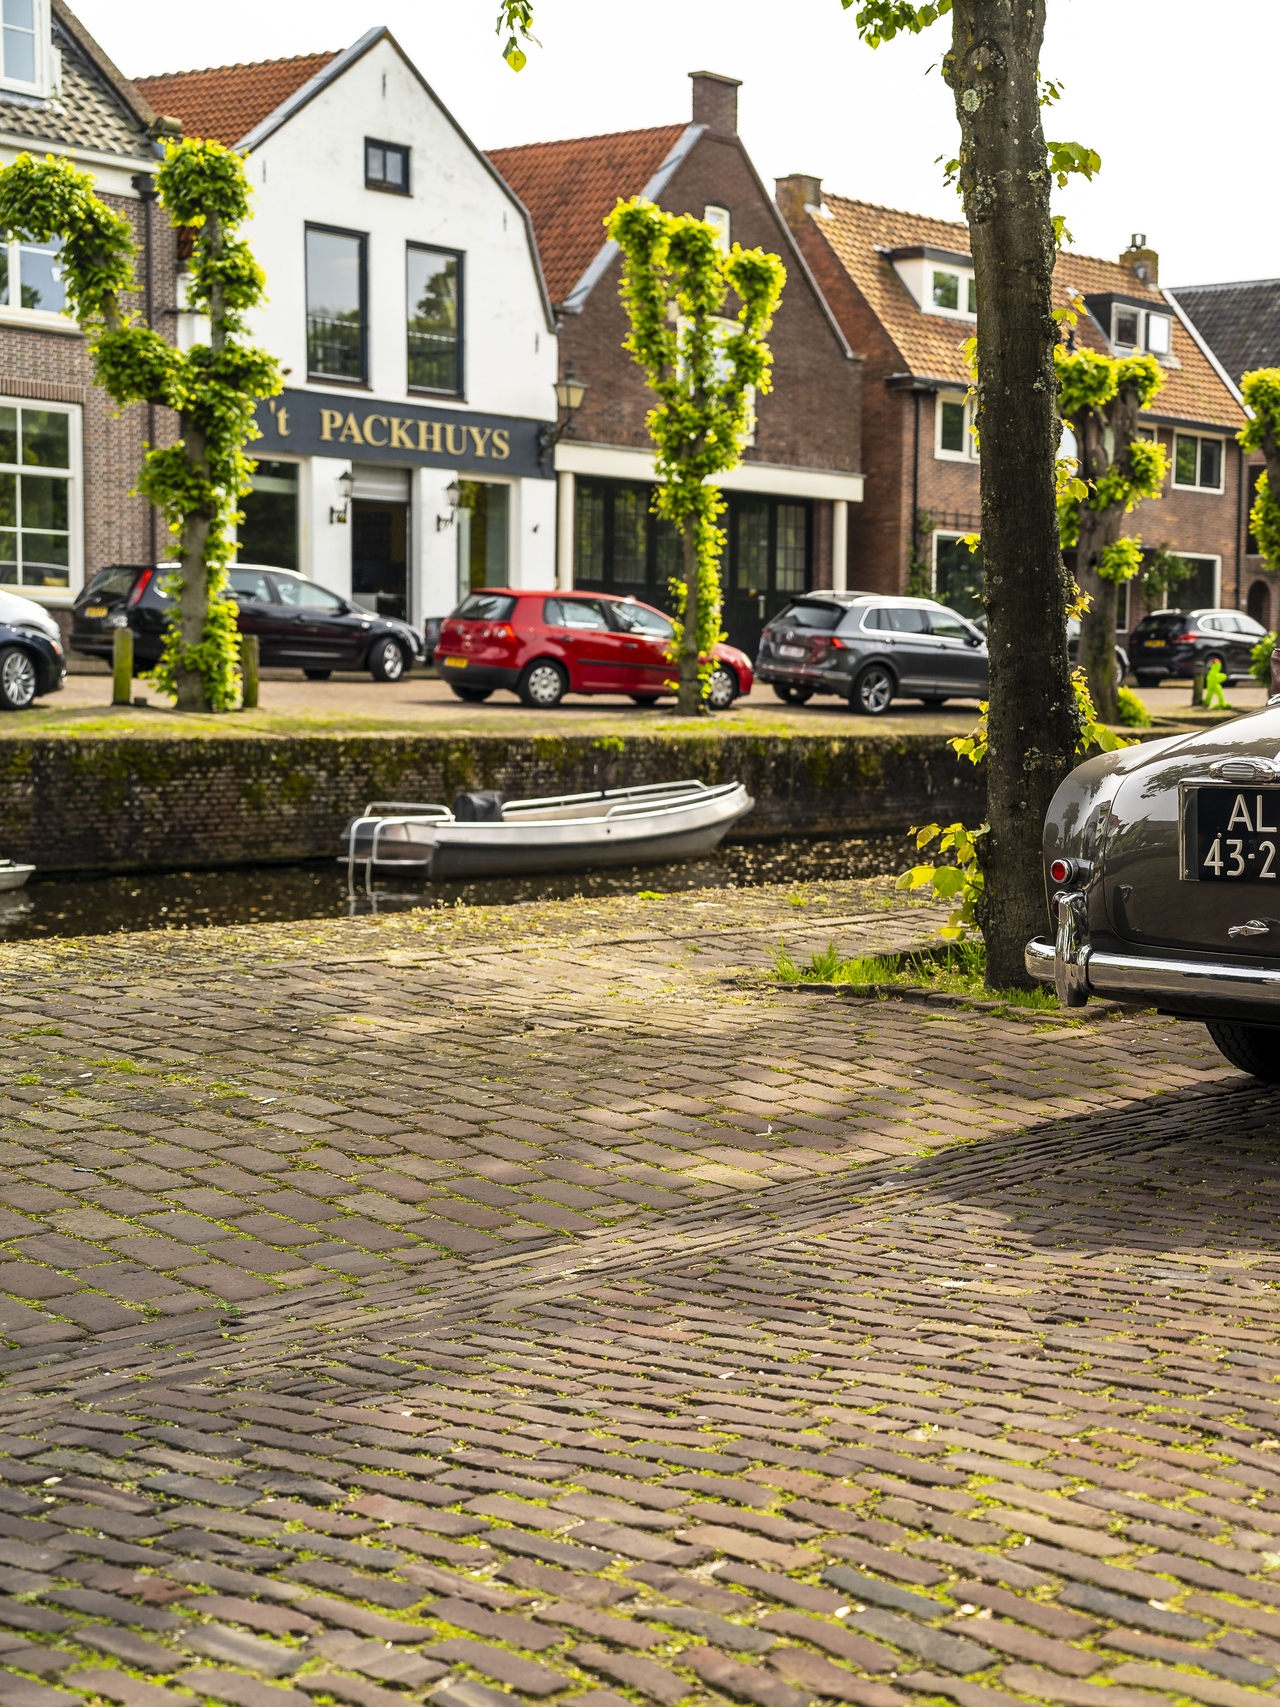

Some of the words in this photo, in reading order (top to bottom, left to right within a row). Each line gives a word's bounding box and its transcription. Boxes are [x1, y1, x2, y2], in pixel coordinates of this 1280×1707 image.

[269, 401, 291, 437] 't
[319, 408, 511, 461] PACKHUYS
[1226, 793, 1278, 833] AL
